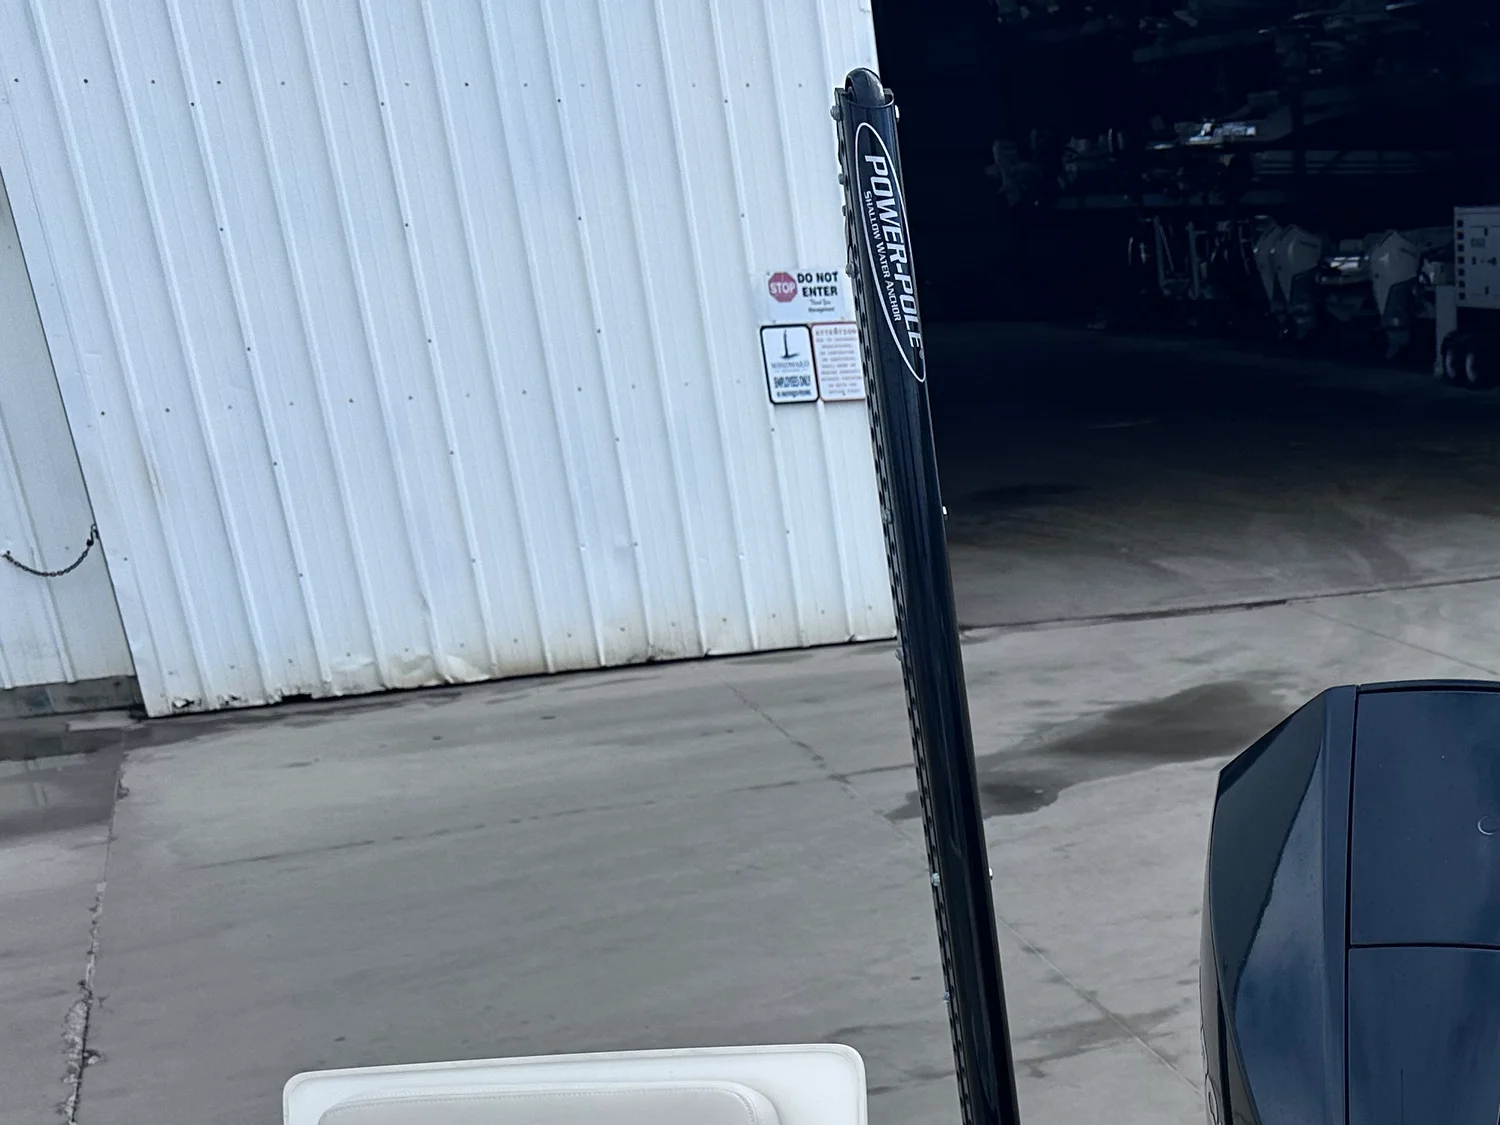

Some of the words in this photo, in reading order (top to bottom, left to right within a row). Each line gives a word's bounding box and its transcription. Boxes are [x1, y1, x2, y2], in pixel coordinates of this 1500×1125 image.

[863, 190, 882, 240] SHALLOW
[876, 242, 891, 278] WATER
[885, 280, 902, 322] ANCHOR
[864, 154, 923, 348] POWER-POLE
[797, 273, 813, 283] DO
[816, 271, 838, 282] NOT
[769, 282, 796, 294] STOP
[802, 286, 838, 297] ENTER
